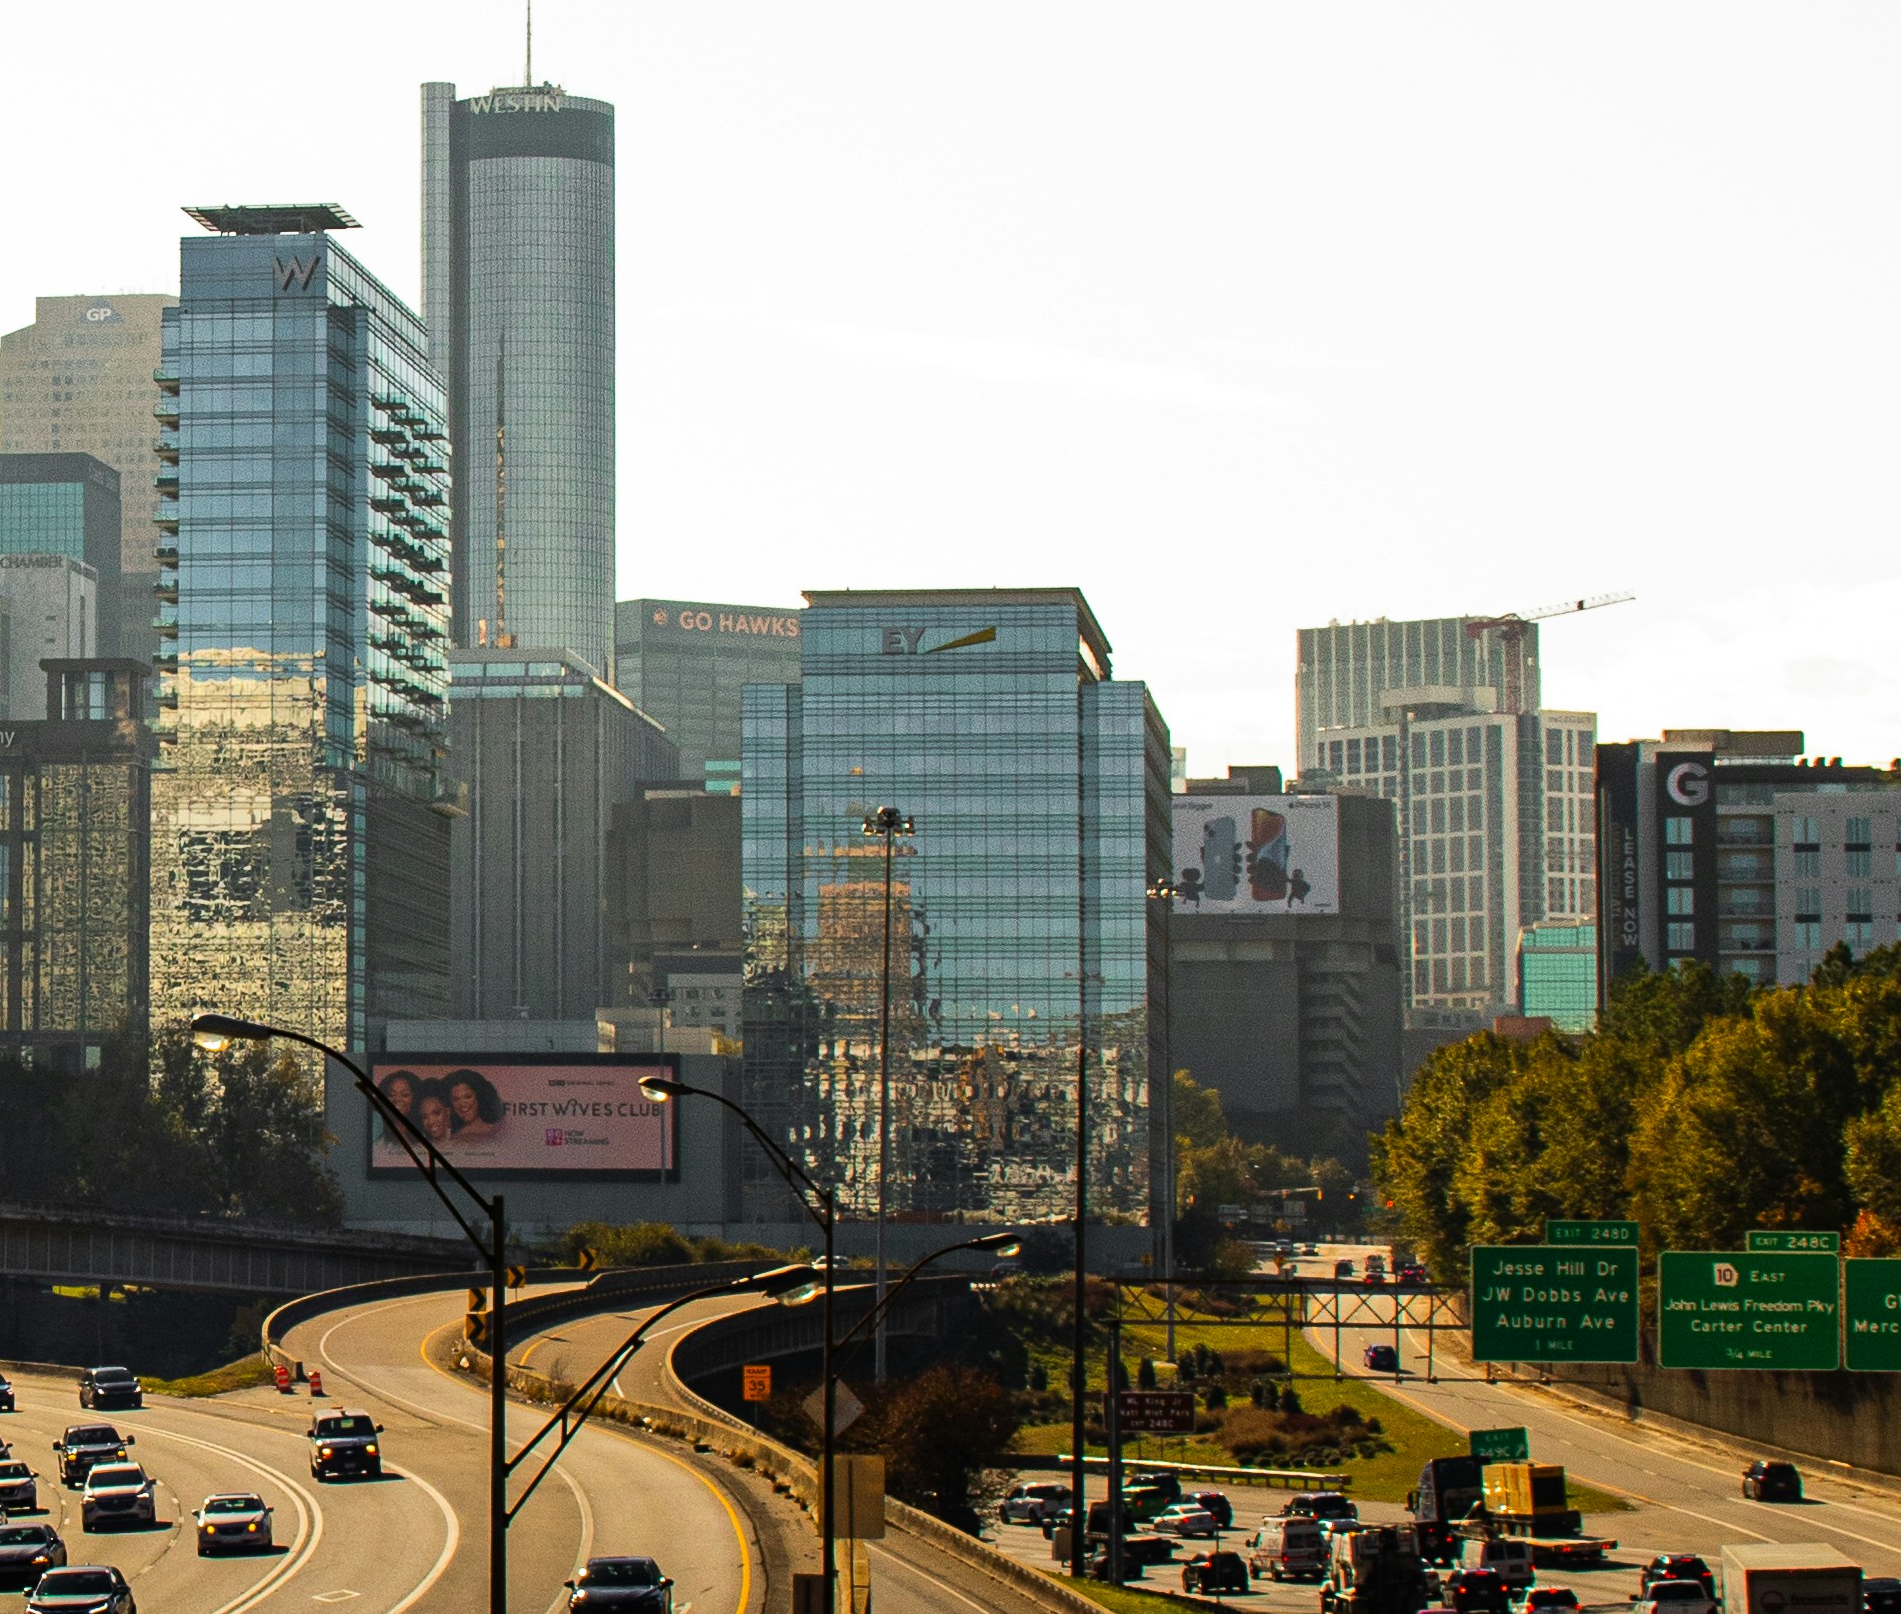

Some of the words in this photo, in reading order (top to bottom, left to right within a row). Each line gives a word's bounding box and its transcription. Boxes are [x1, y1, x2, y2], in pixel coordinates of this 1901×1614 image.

[470, 95, 560, 115] WESTIN
[271, 256, 321, 291] W
[86, 308, 111, 321] GP
[0, 555, 63, 569] CHAMBER
[680, 611, 713, 631] GO
[720, 612, 798, 637] HAWKS
[882, 626, 926, 655] EY
[1666, 762, 1709, 806] G
[1624, 828, 1636, 898] LEASE
[1623, 907, 1639, 947] NOW
[503, 1102, 548, 1116] FIRST
[552, 1099, 613, 1117] WIVES
[617, 1103, 661, 1117] CLUB
[1555, 1228, 1581, 1238] EXIT
[1592, 1228, 1629, 1240] 248D
[1755, 1237, 1779, 1246] EXIT
[1787, 1237, 1830, 1248] 248C
[1493, 1261, 1544, 1275] Jesse
[1557, 1261, 1585, 1276] Hill
[1597, 1261, 1619, 1276] Dr
[1716, 1268, 1733, 1283] 10
[1751, 1271, 1786, 1282] EAST
[1482, 1287, 1511, 1302] JW
[1523, 1287, 1581, 1302] Dobbs
[1594, 1288, 1629, 1303] Ave
[1664, 1299, 1697, 1311] John
[1701, 1299, 1740, 1312] Lewis
[1744, 1299, 1803, 1312] Freedom
[1807, 1300, 1835, 1315] Pky
[1496, 1313, 1567, 1329] Auburn
[1580, 1313, 1615, 1329] Ave
[1691, 1319, 1744, 1333] Carter
[1753, 1320, 1808, 1333] Center
[1548, 1340, 1574, 1350] MILE
[1748, 1350, 1772, 1359] MILE
[749, 1380, 766, 1391] 35
[1145, 1398, 1165, 1406] King
